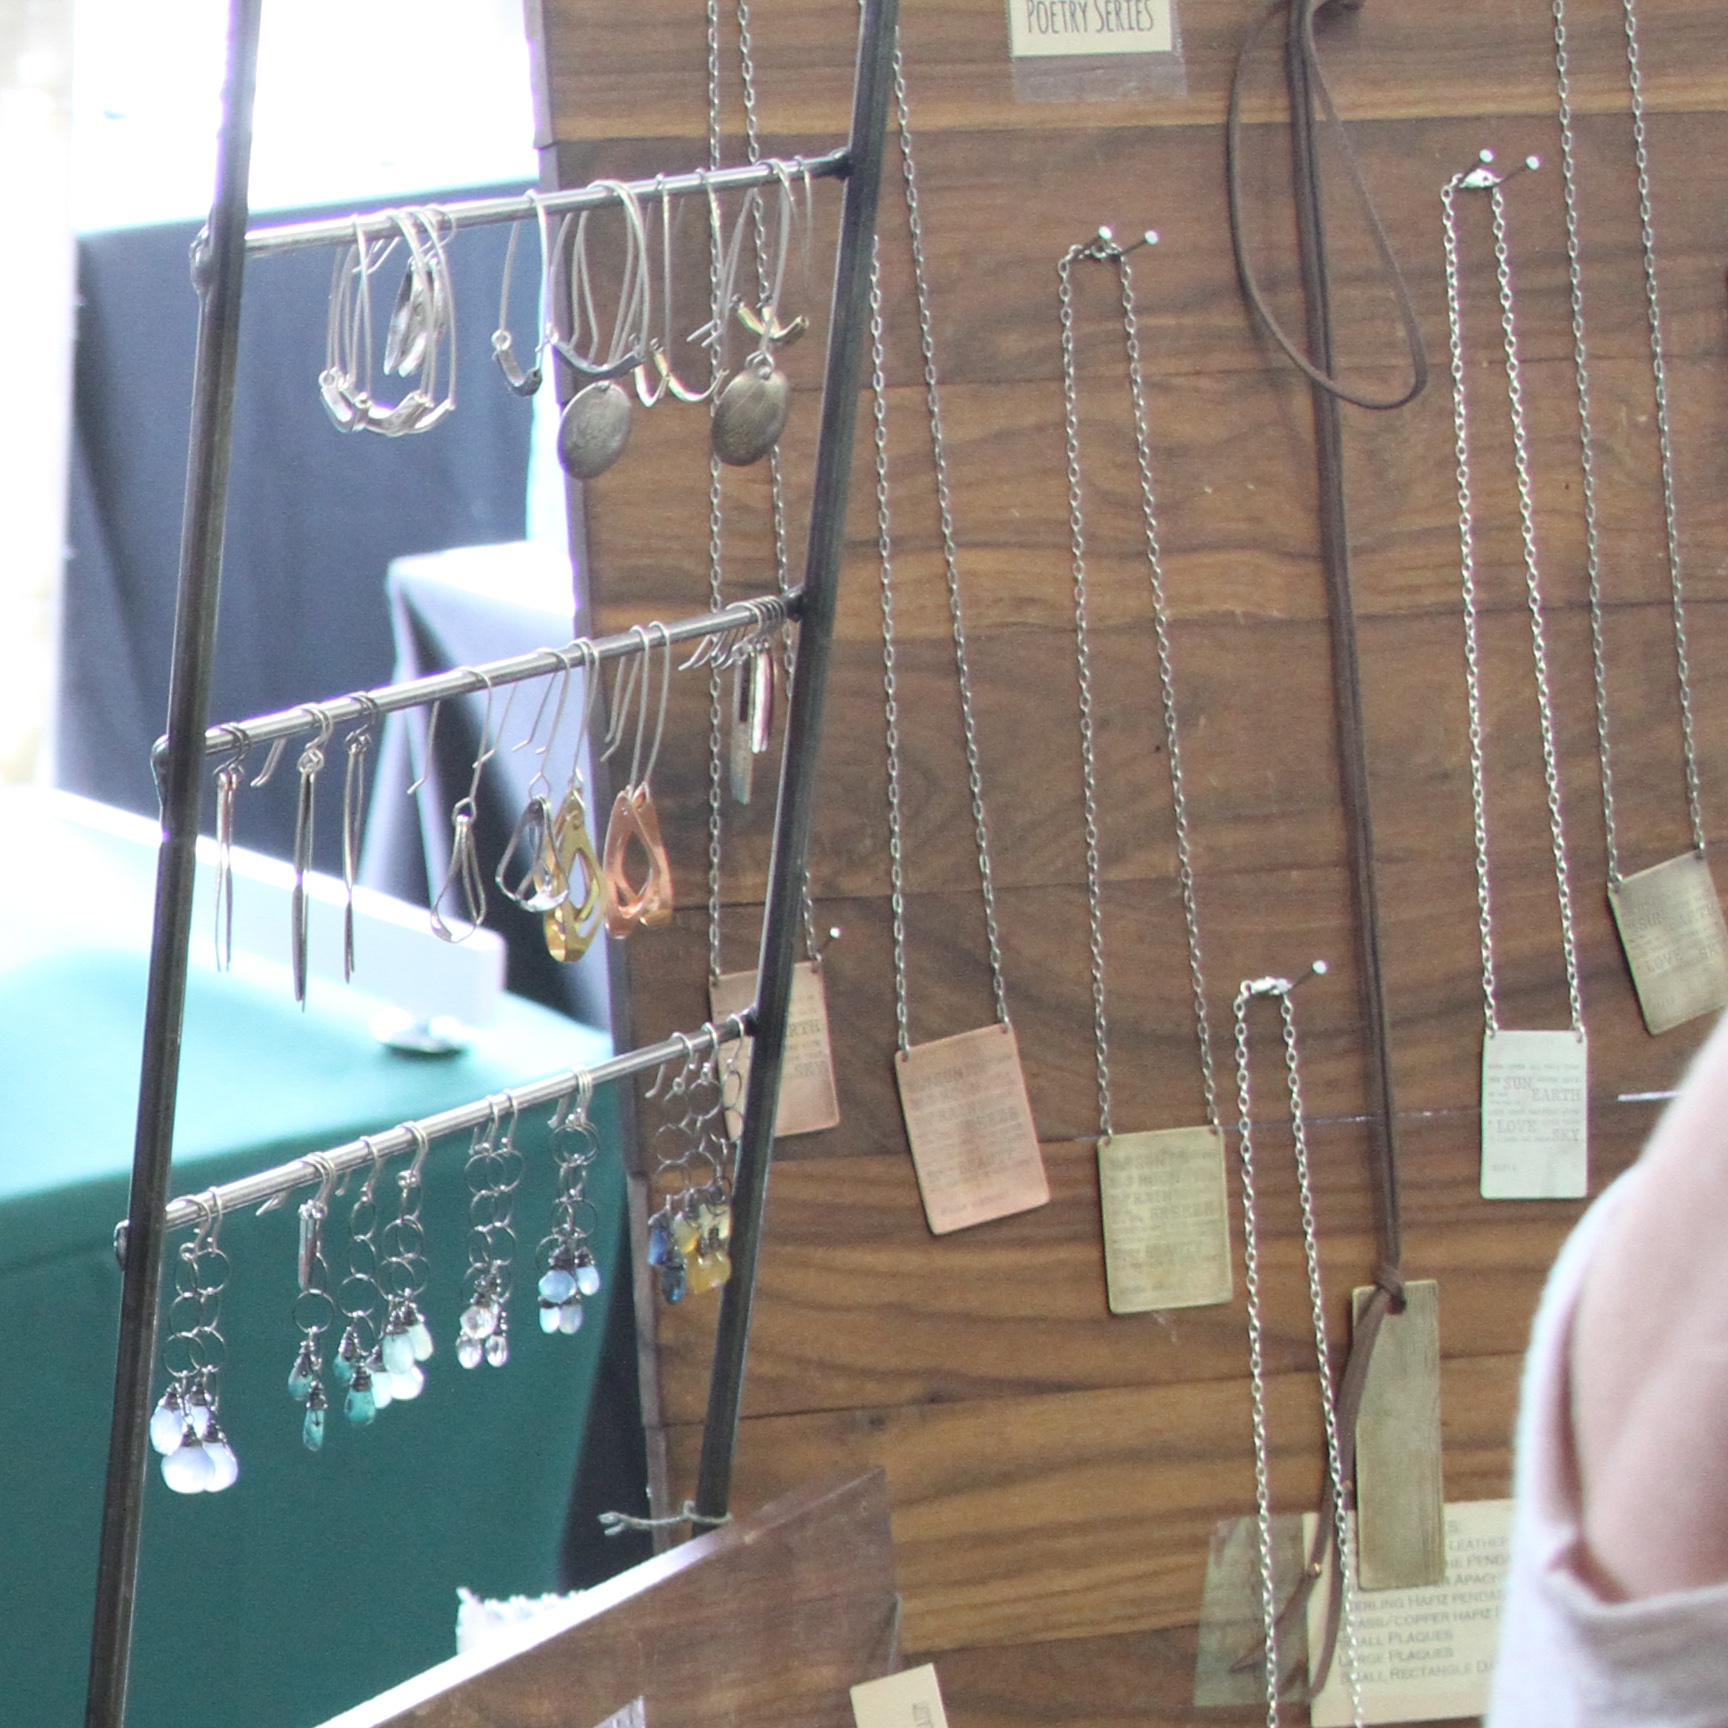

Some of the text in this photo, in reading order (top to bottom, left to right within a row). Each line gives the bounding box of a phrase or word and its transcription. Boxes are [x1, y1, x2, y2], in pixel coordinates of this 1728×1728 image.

[1027, 0, 1154, 34] POETRY SERIES
[1345, 1597, 1404, 1612] TERLING
[1338, 1633, 1384, 1649] SALL
[1339, 1669, 1385, 1684] SALL
